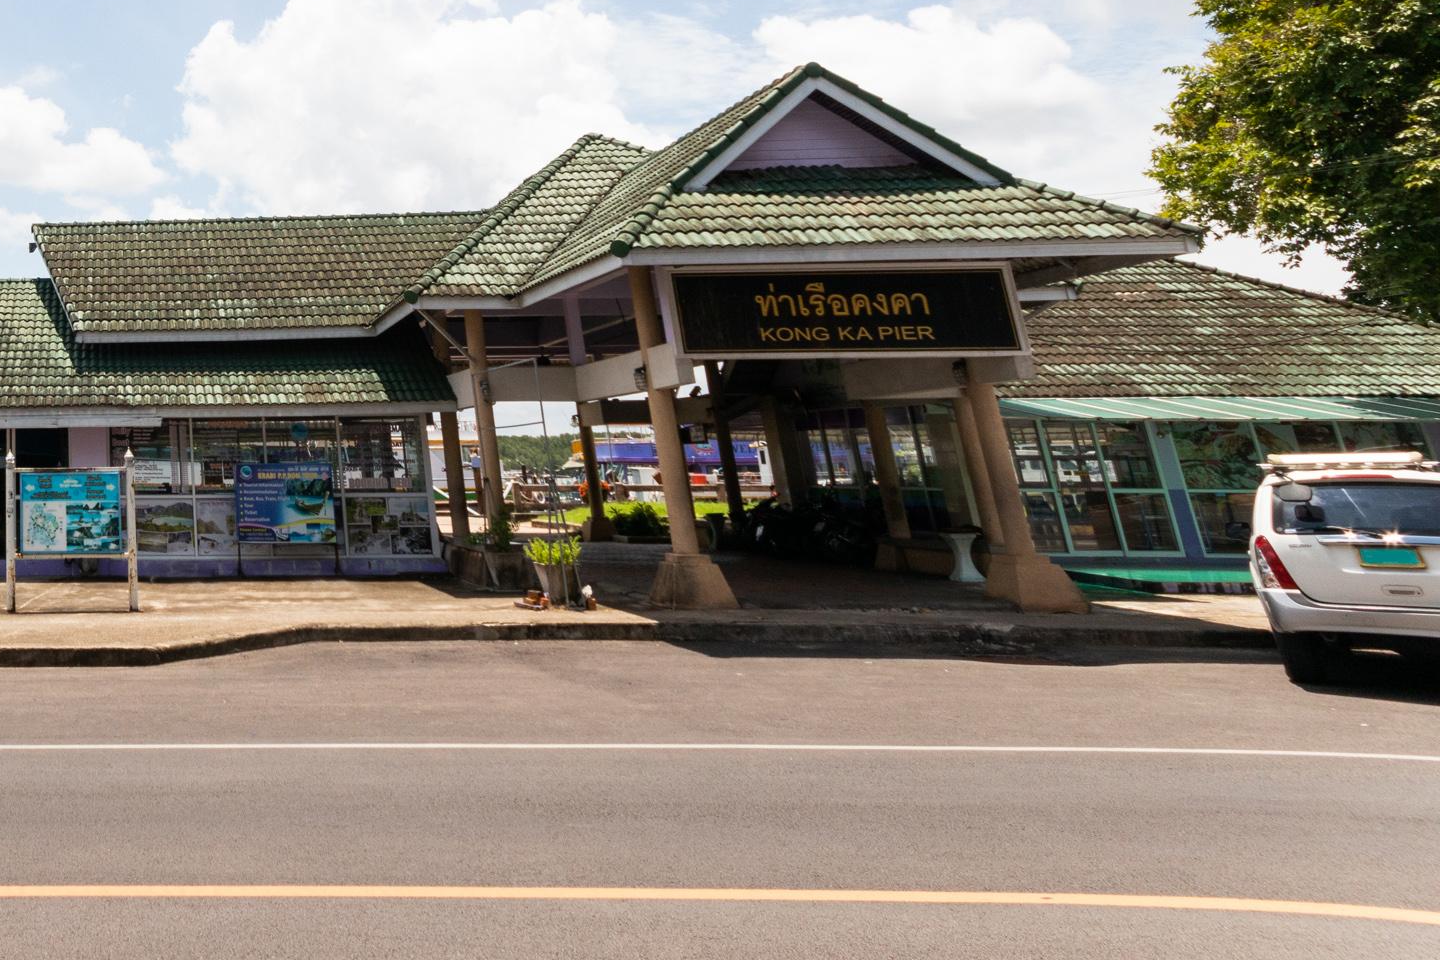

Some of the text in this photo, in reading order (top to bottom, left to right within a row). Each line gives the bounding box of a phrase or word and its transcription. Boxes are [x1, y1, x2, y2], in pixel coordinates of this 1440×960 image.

[754, 282, 930, 317] ท่าเรือคงคา
[760, 326, 935, 342] KONG KA PIER
